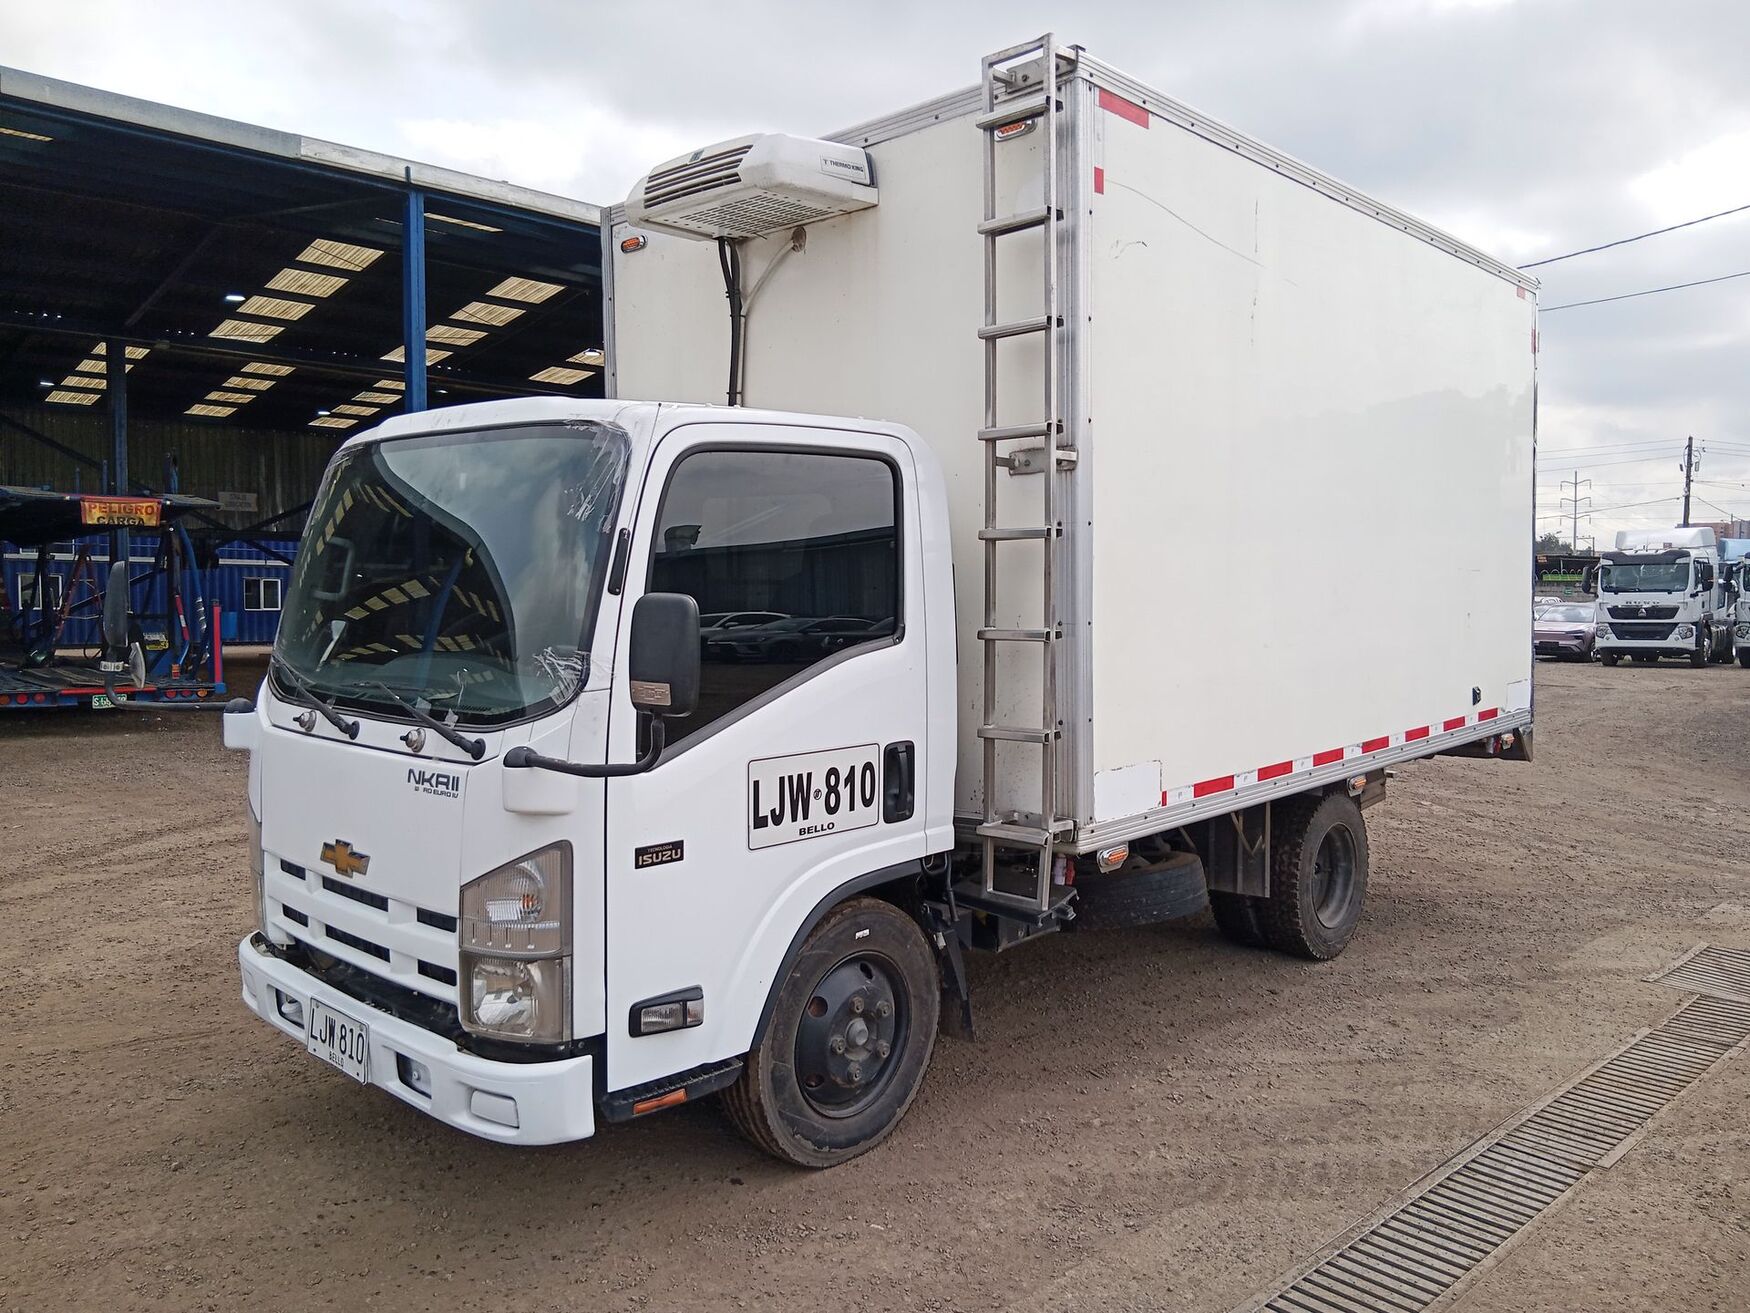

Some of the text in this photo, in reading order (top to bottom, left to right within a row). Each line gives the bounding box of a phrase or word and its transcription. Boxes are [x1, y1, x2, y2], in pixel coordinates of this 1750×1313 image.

[830, 160, 851, 169] THERMO
[851, 164, 864, 172] KING
[88, 503, 155, 515] PELIGRO
[97, 516, 145, 526] CARGA
[433, 789, 451, 798] EURO
[753, 761, 876, 830] LJW 810
[799, 822, 835, 836] BELLO
[639, 849, 681, 866] ISUZU
[310, 1008, 365, 1065] LJW 810
[329, 1050, 345, 1068] BELLO
